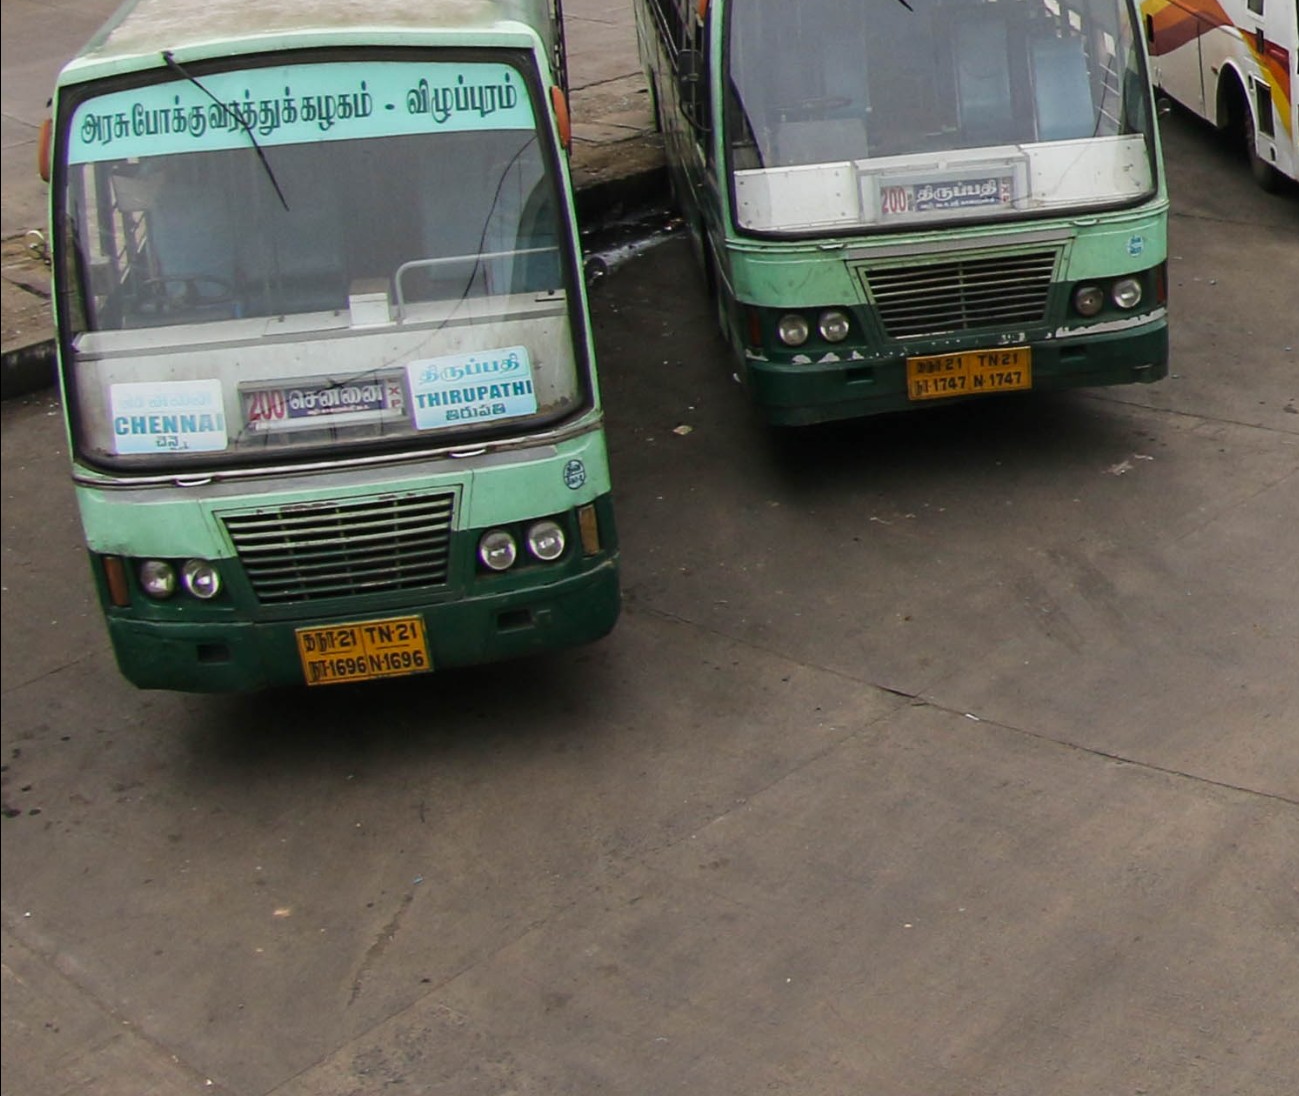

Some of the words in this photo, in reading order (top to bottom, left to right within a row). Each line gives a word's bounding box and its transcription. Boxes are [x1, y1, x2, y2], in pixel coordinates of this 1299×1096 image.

[407, 72, 516, 123] விழுப்புரம்
[882, 186, 907, 214] 200
[916, 179, 997, 203] திருப்பதி
[419, 353, 520, 385] திருப்பதி
[248, 390, 285, 421] 200
[415, 380, 532, 408] THIRUPATHI
[115, 414, 224, 435] CHENNAI
